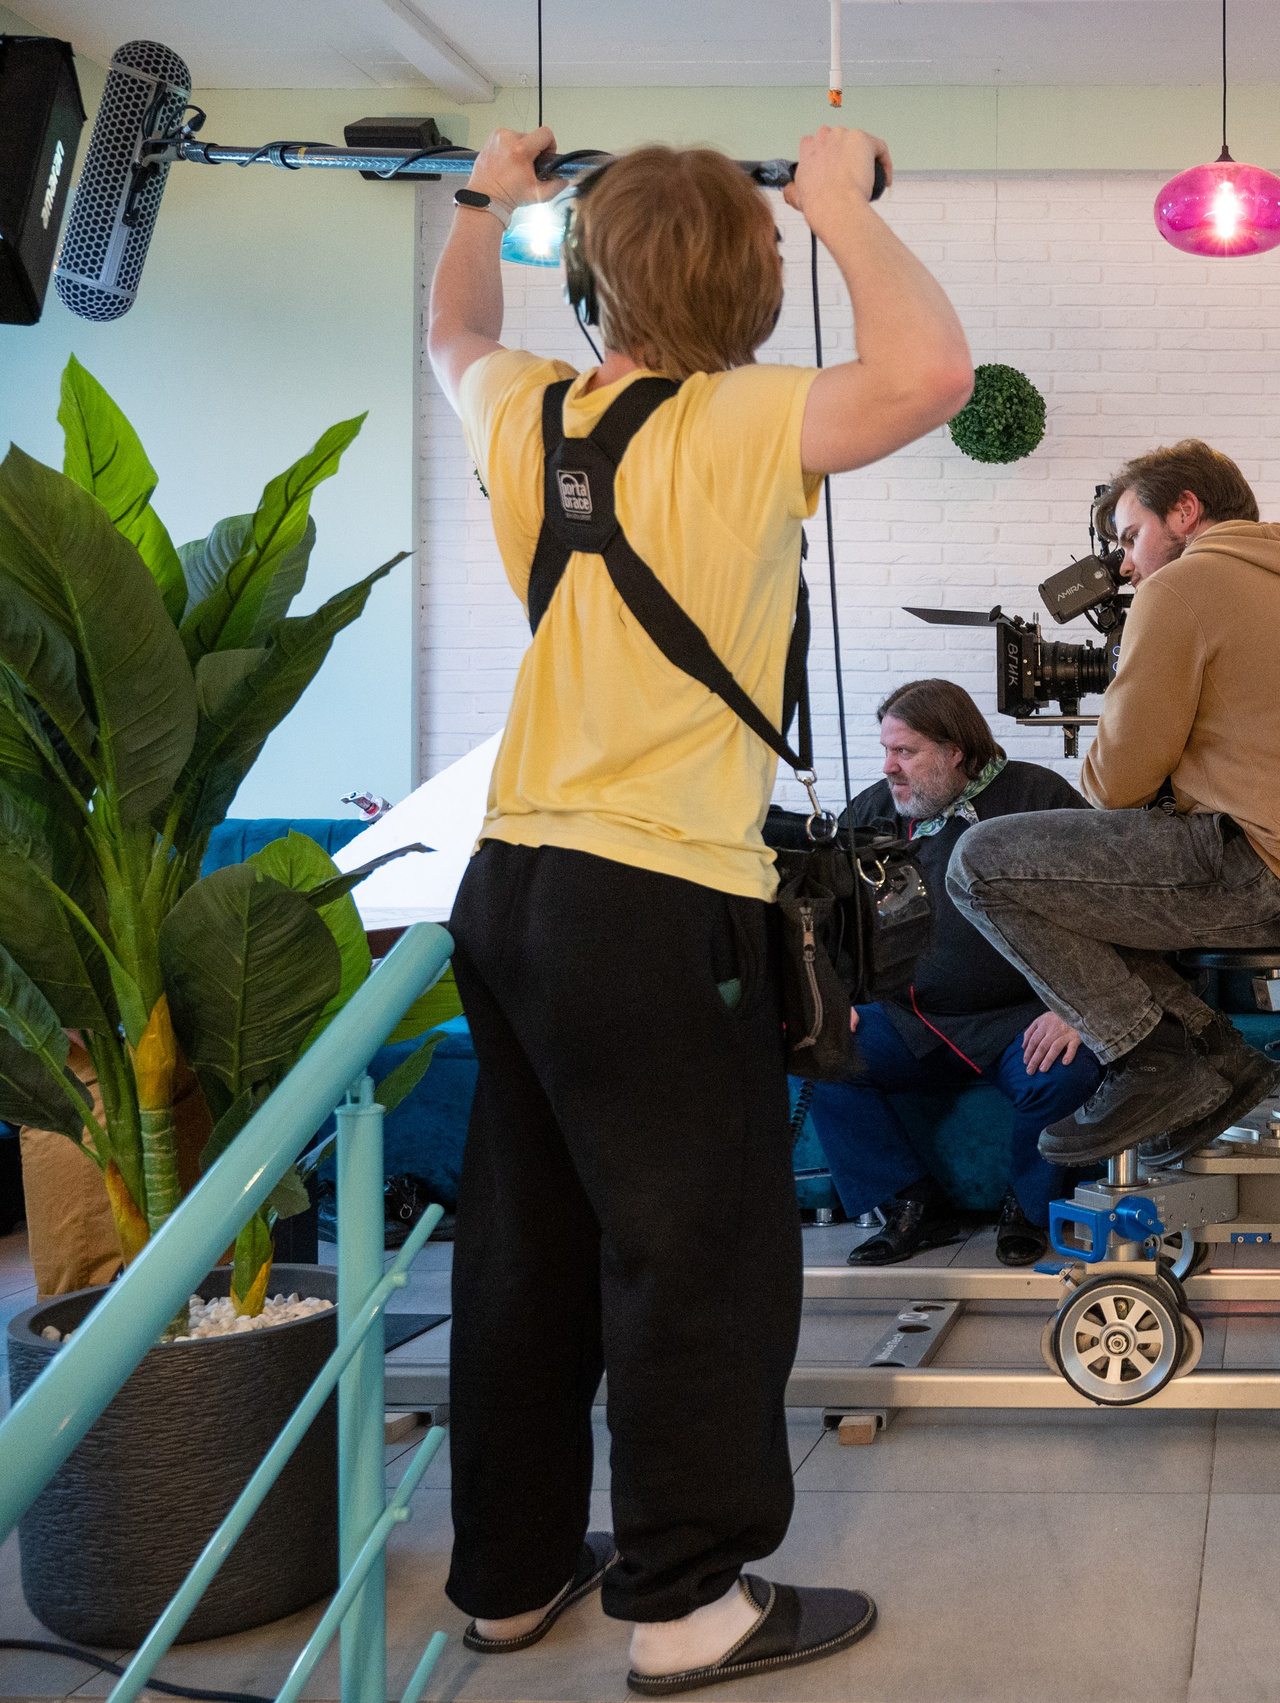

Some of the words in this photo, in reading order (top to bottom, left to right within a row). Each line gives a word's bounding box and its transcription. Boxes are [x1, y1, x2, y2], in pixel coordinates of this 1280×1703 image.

[563, 496, 590, 511] brace
[1057, 583, 1085, 602] AMIRA
[1007, 643, 1019, 686] ВГИК
